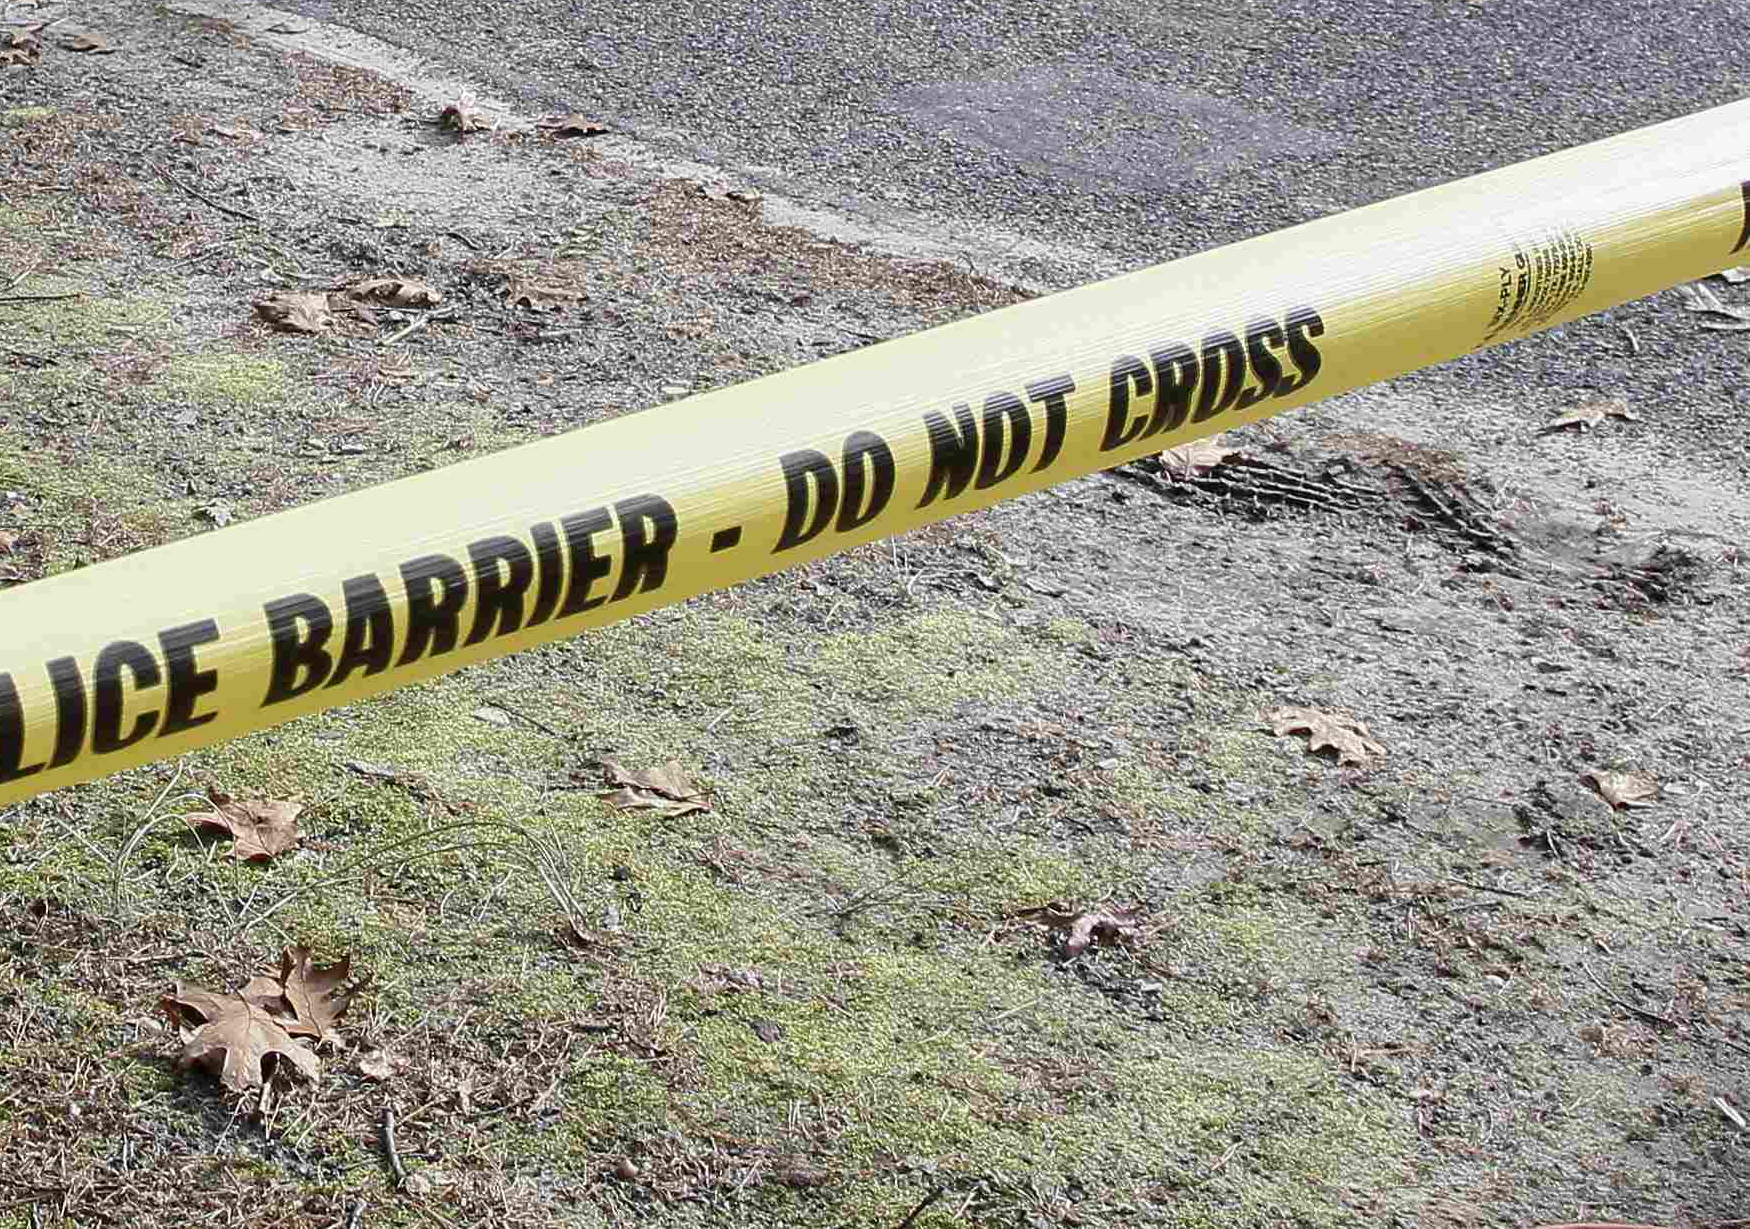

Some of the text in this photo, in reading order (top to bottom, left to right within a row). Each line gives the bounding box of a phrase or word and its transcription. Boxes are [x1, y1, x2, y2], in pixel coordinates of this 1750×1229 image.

[260, 493, 679, 708] BARRIER
[772, 429, 896, 555] DO
[915, 372, 1077, 511] NOT
[1098, 306, 1326, 452] CROSS
